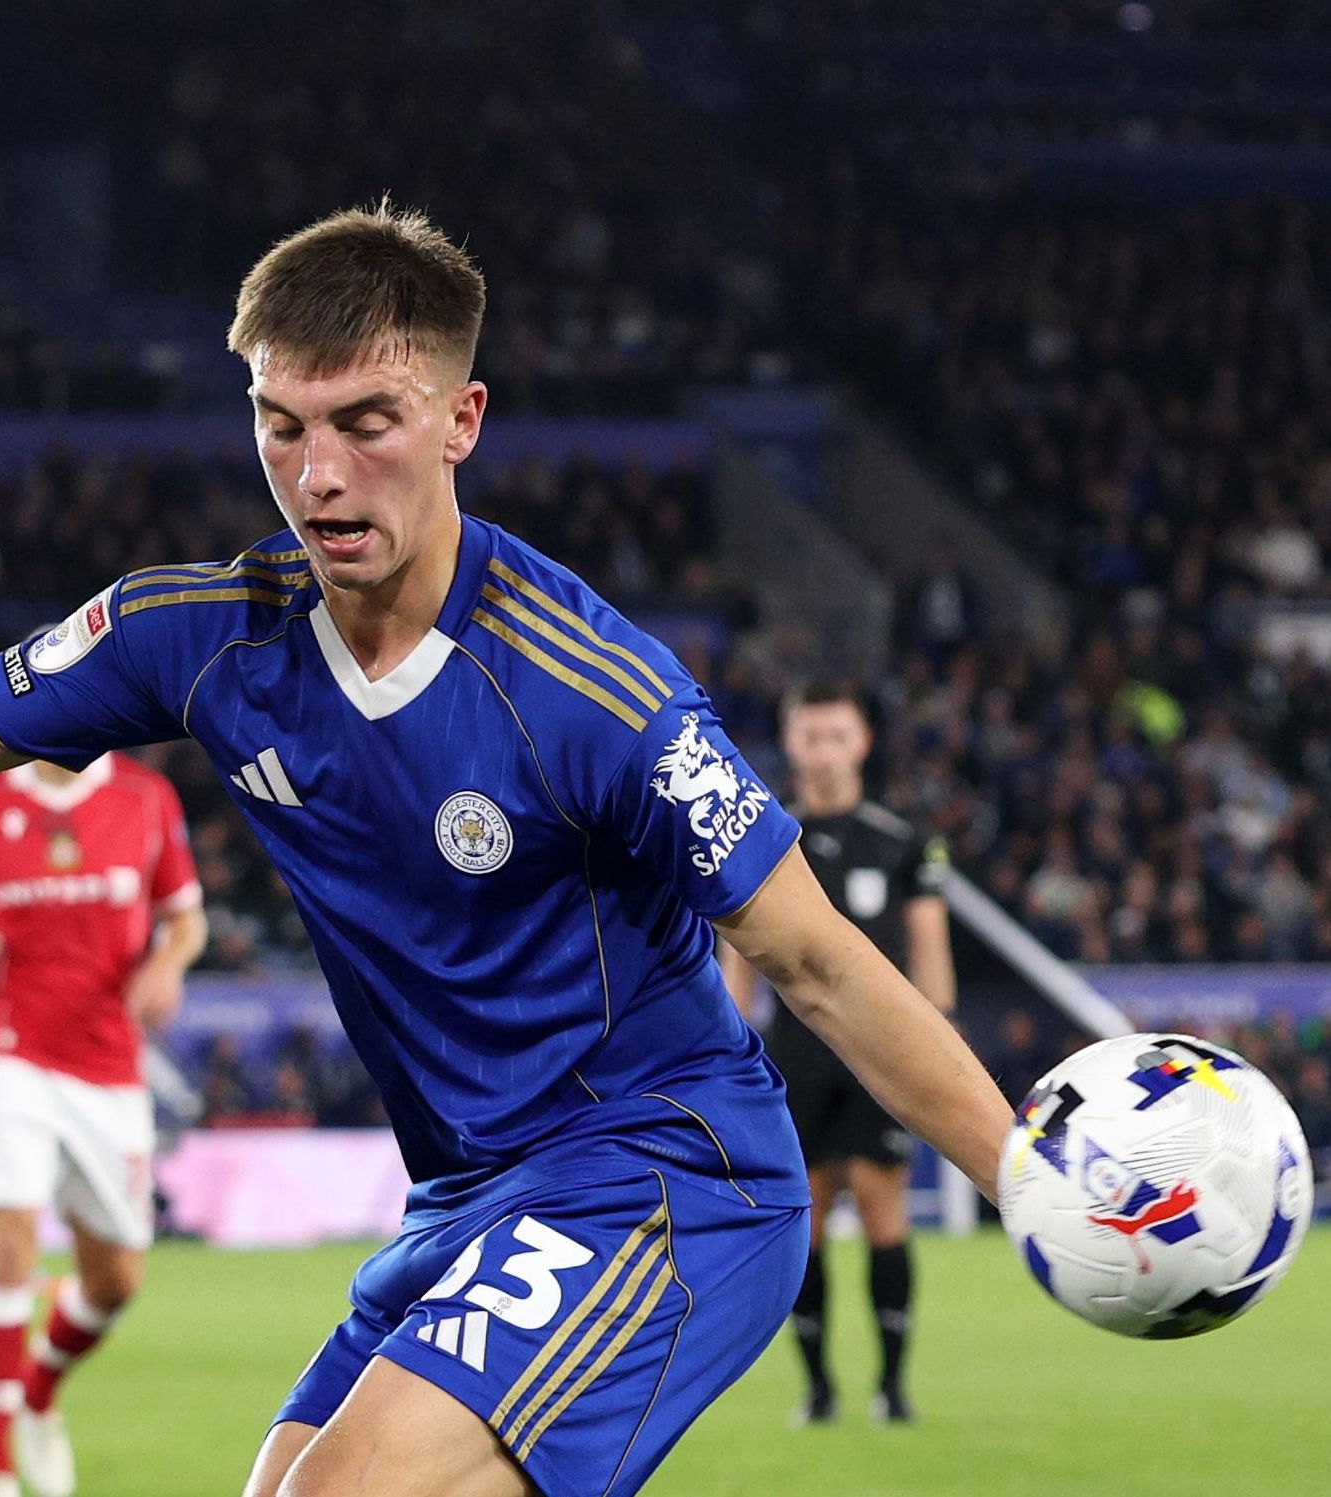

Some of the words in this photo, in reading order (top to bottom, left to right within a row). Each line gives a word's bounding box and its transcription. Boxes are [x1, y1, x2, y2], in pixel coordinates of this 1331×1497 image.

[442, 798, 486, 828] LEICESTER
[486, 809, 505, 833] CITY
[692, 783, 766, 877] SAIGON
[711, 800, 737, 830] BIA
[442, 834, 488, 867] FOOTBALL
[487, 837, 506, 864] CLUB
